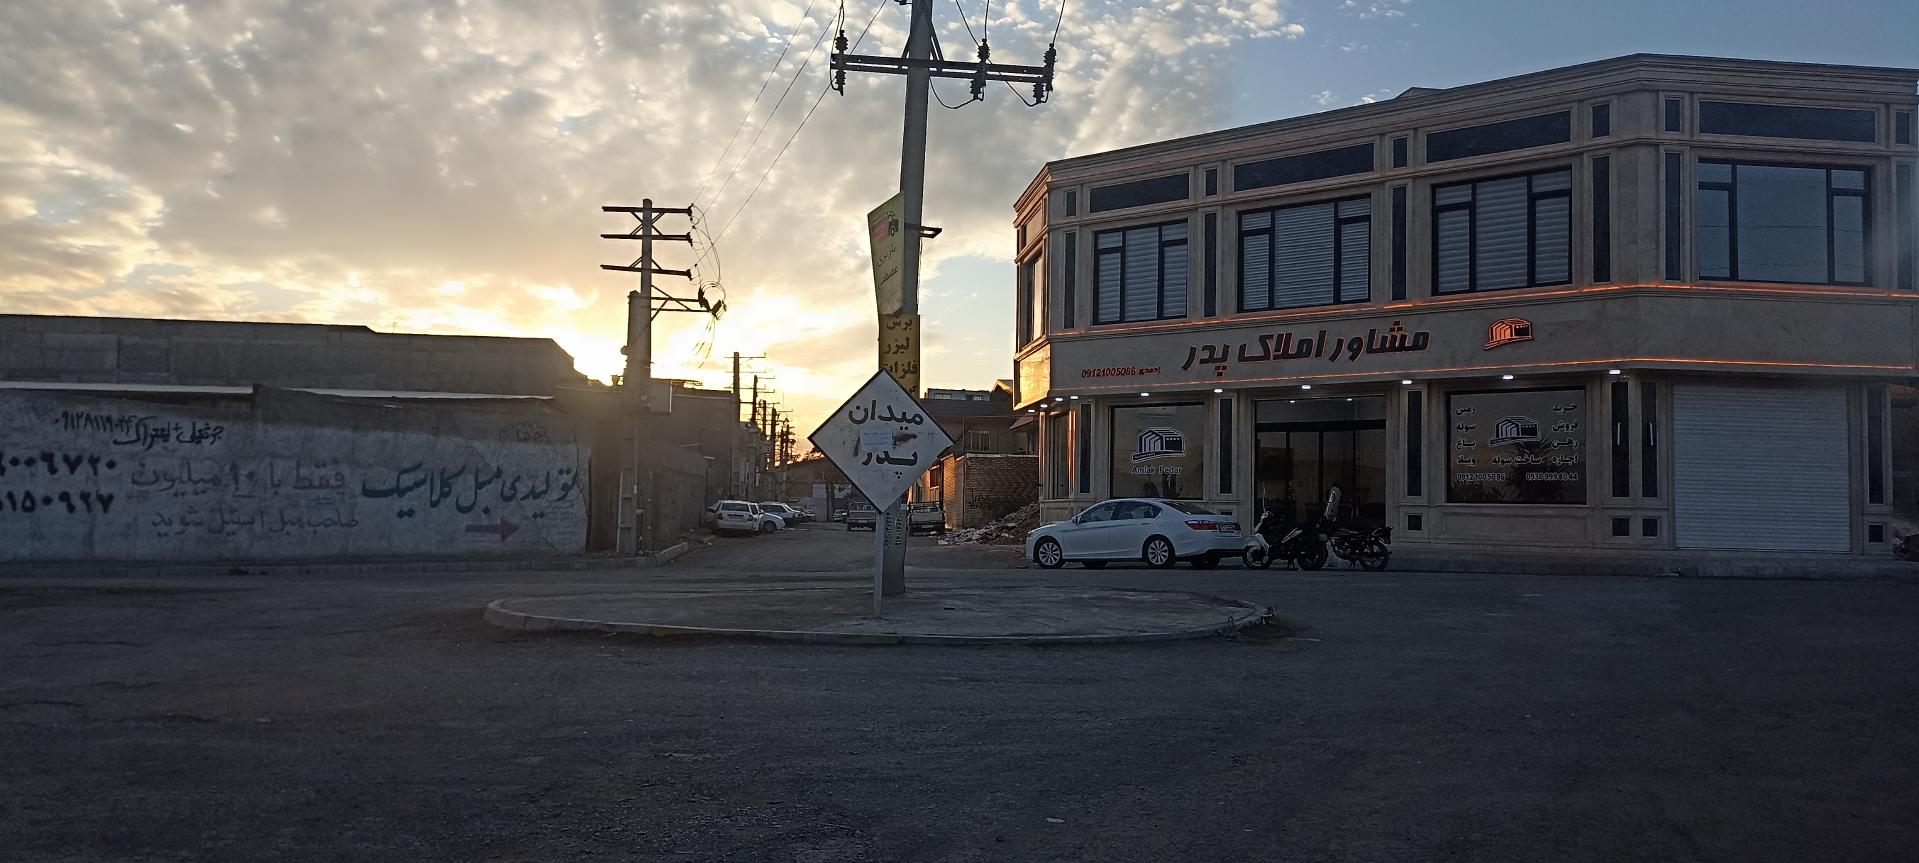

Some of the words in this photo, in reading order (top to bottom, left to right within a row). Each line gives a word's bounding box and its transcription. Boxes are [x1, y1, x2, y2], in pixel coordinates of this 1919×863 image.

[883, 336, 910, 355] لیزر
[1239, 329, 1327, 362] املاک
[1329, 320, 1431, 362] مشاور
[1081, 367, 1136, 379] 09121005086
[1181, 343, 1231, 377] پدر
[848, 399, 924, 431] میدان
[1552, 403, 1578, 415] خرید
[1552, 420, 1579, 432] فروش
[1456, 438, 1477, 451] باغ
[1552, 437, 1579, 449] رهن
[292, 459, 346, 491] فقط
[861, 450, 919, 480] پدر
[1552, 453, 1579, 466] اجاره
[131, 458, 223, 498] میلیون
[270, 460, 282, 497] با
[361, 461, 467, 520] کلاسیک
[456, 465, 503, 516] مبل
[268, 507, 304, 537] مبل
